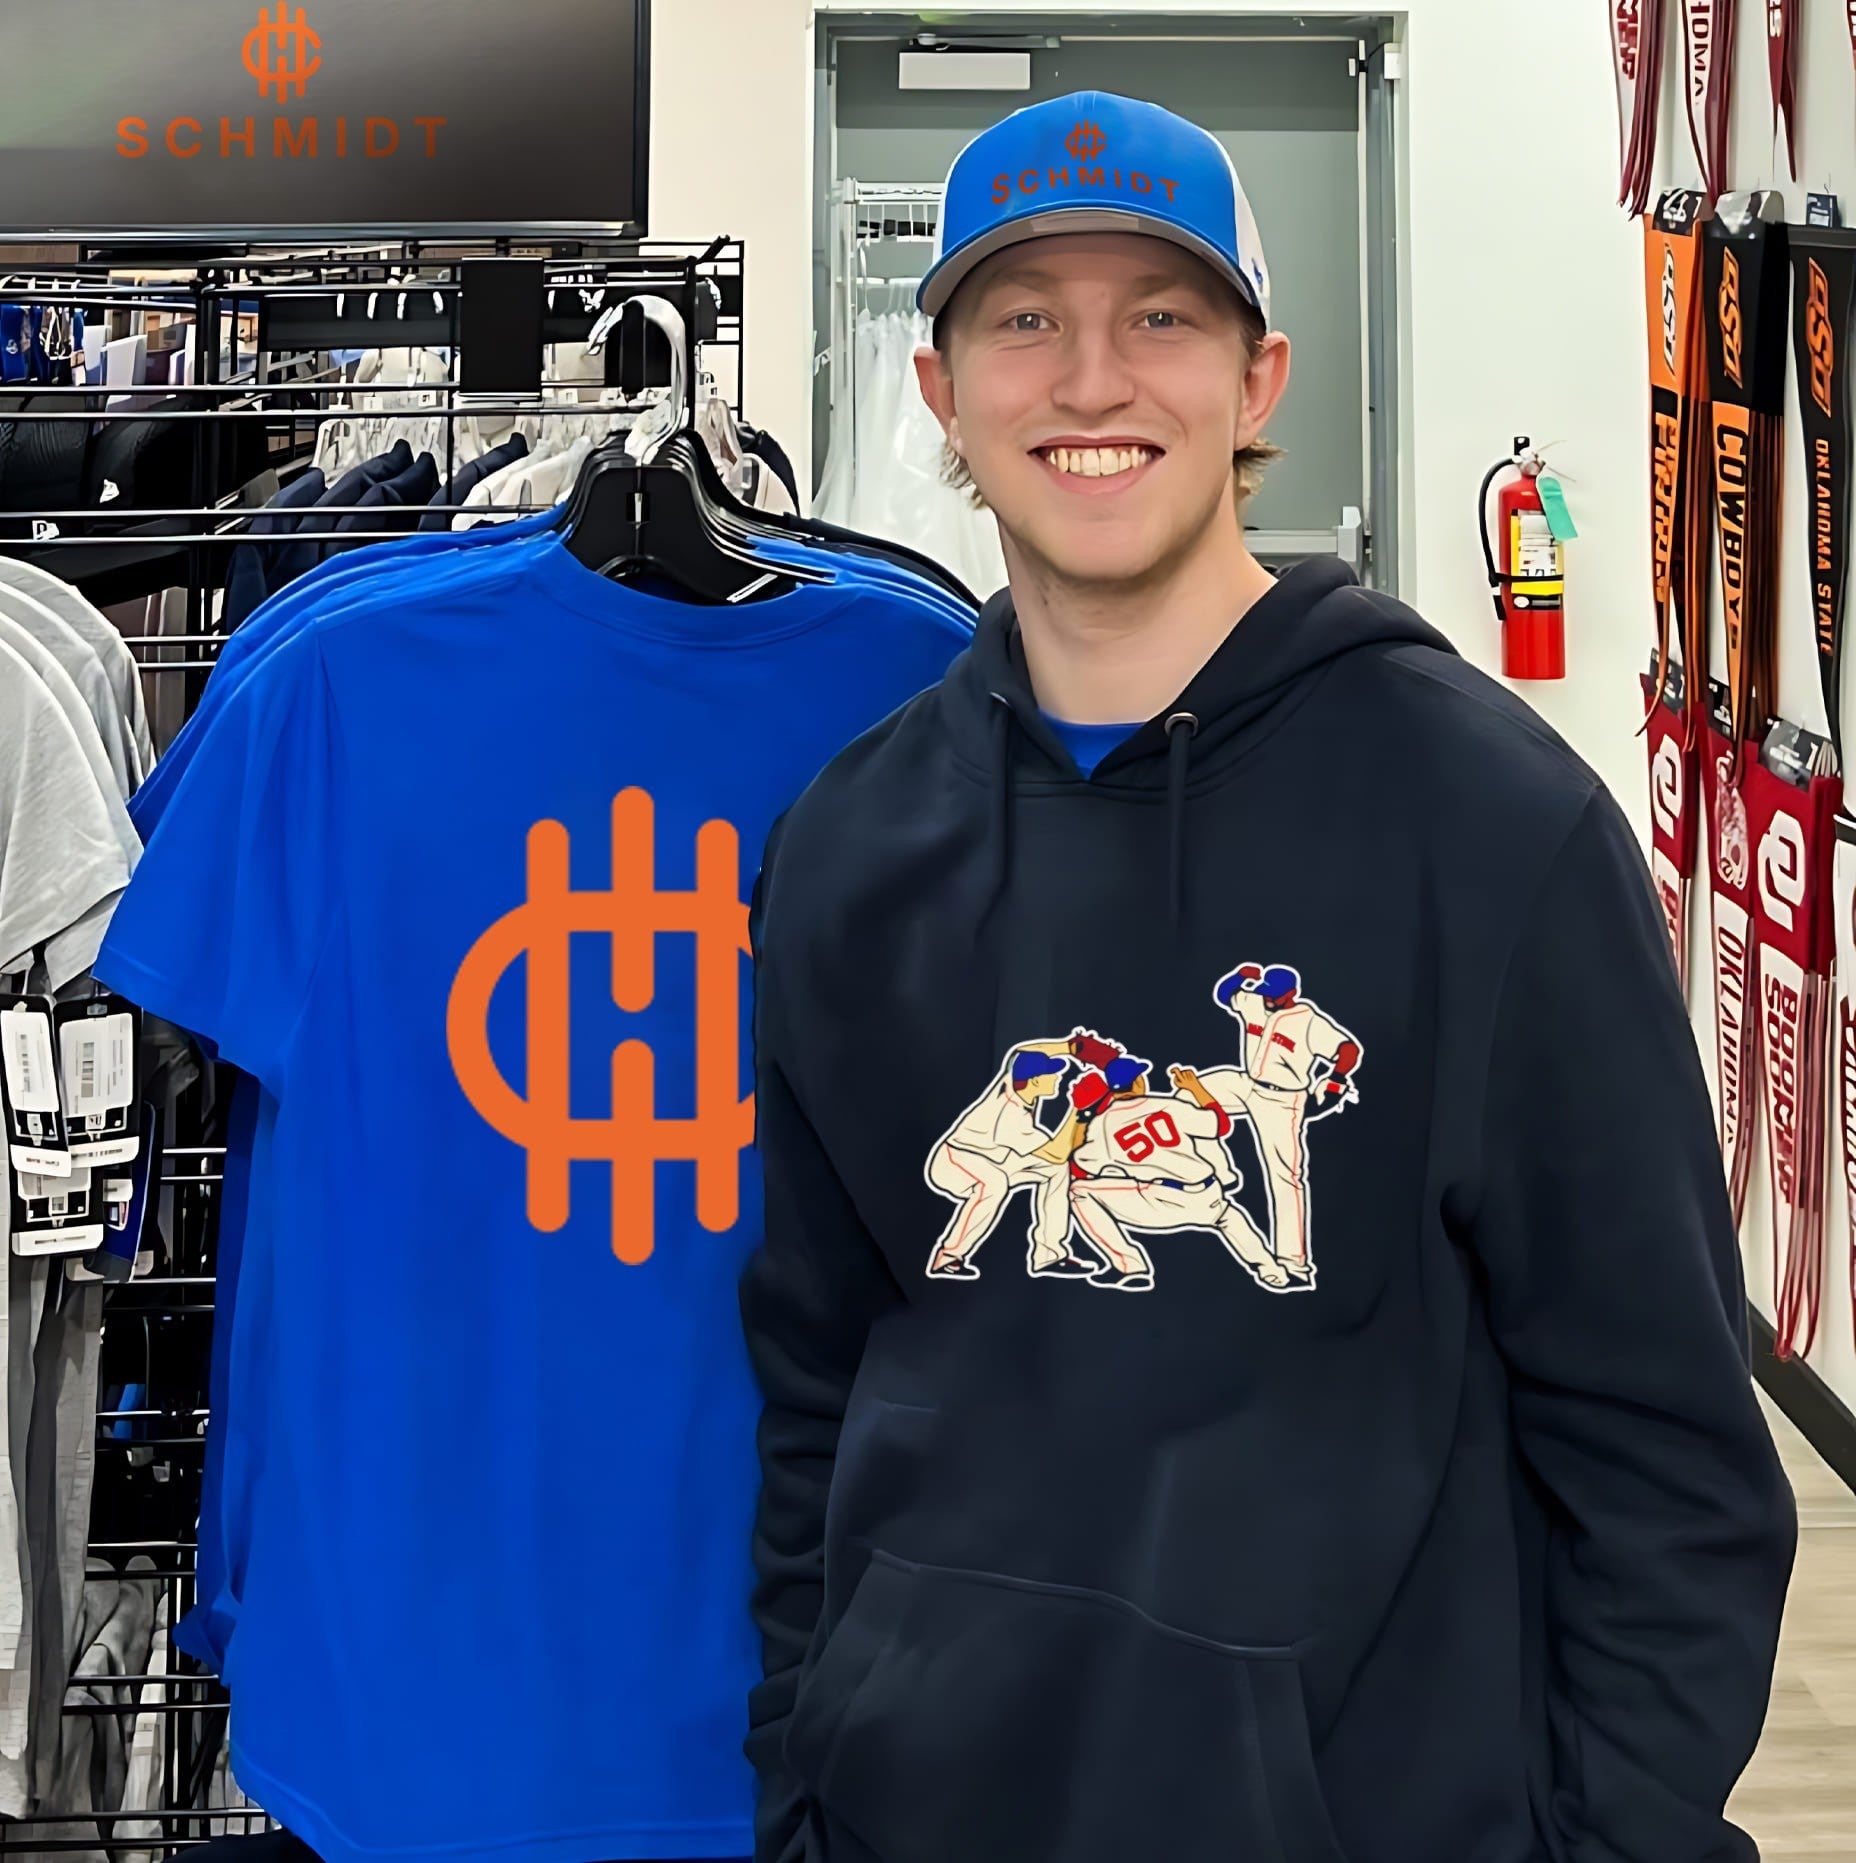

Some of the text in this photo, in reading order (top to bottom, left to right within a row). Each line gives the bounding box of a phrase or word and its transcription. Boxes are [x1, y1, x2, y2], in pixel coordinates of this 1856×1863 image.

[115, 117, 447, 158] SCHMIDT
[991, 167, 1180, 204] SCHMIDT
[1113, 1110, 1181, 1163] 50
